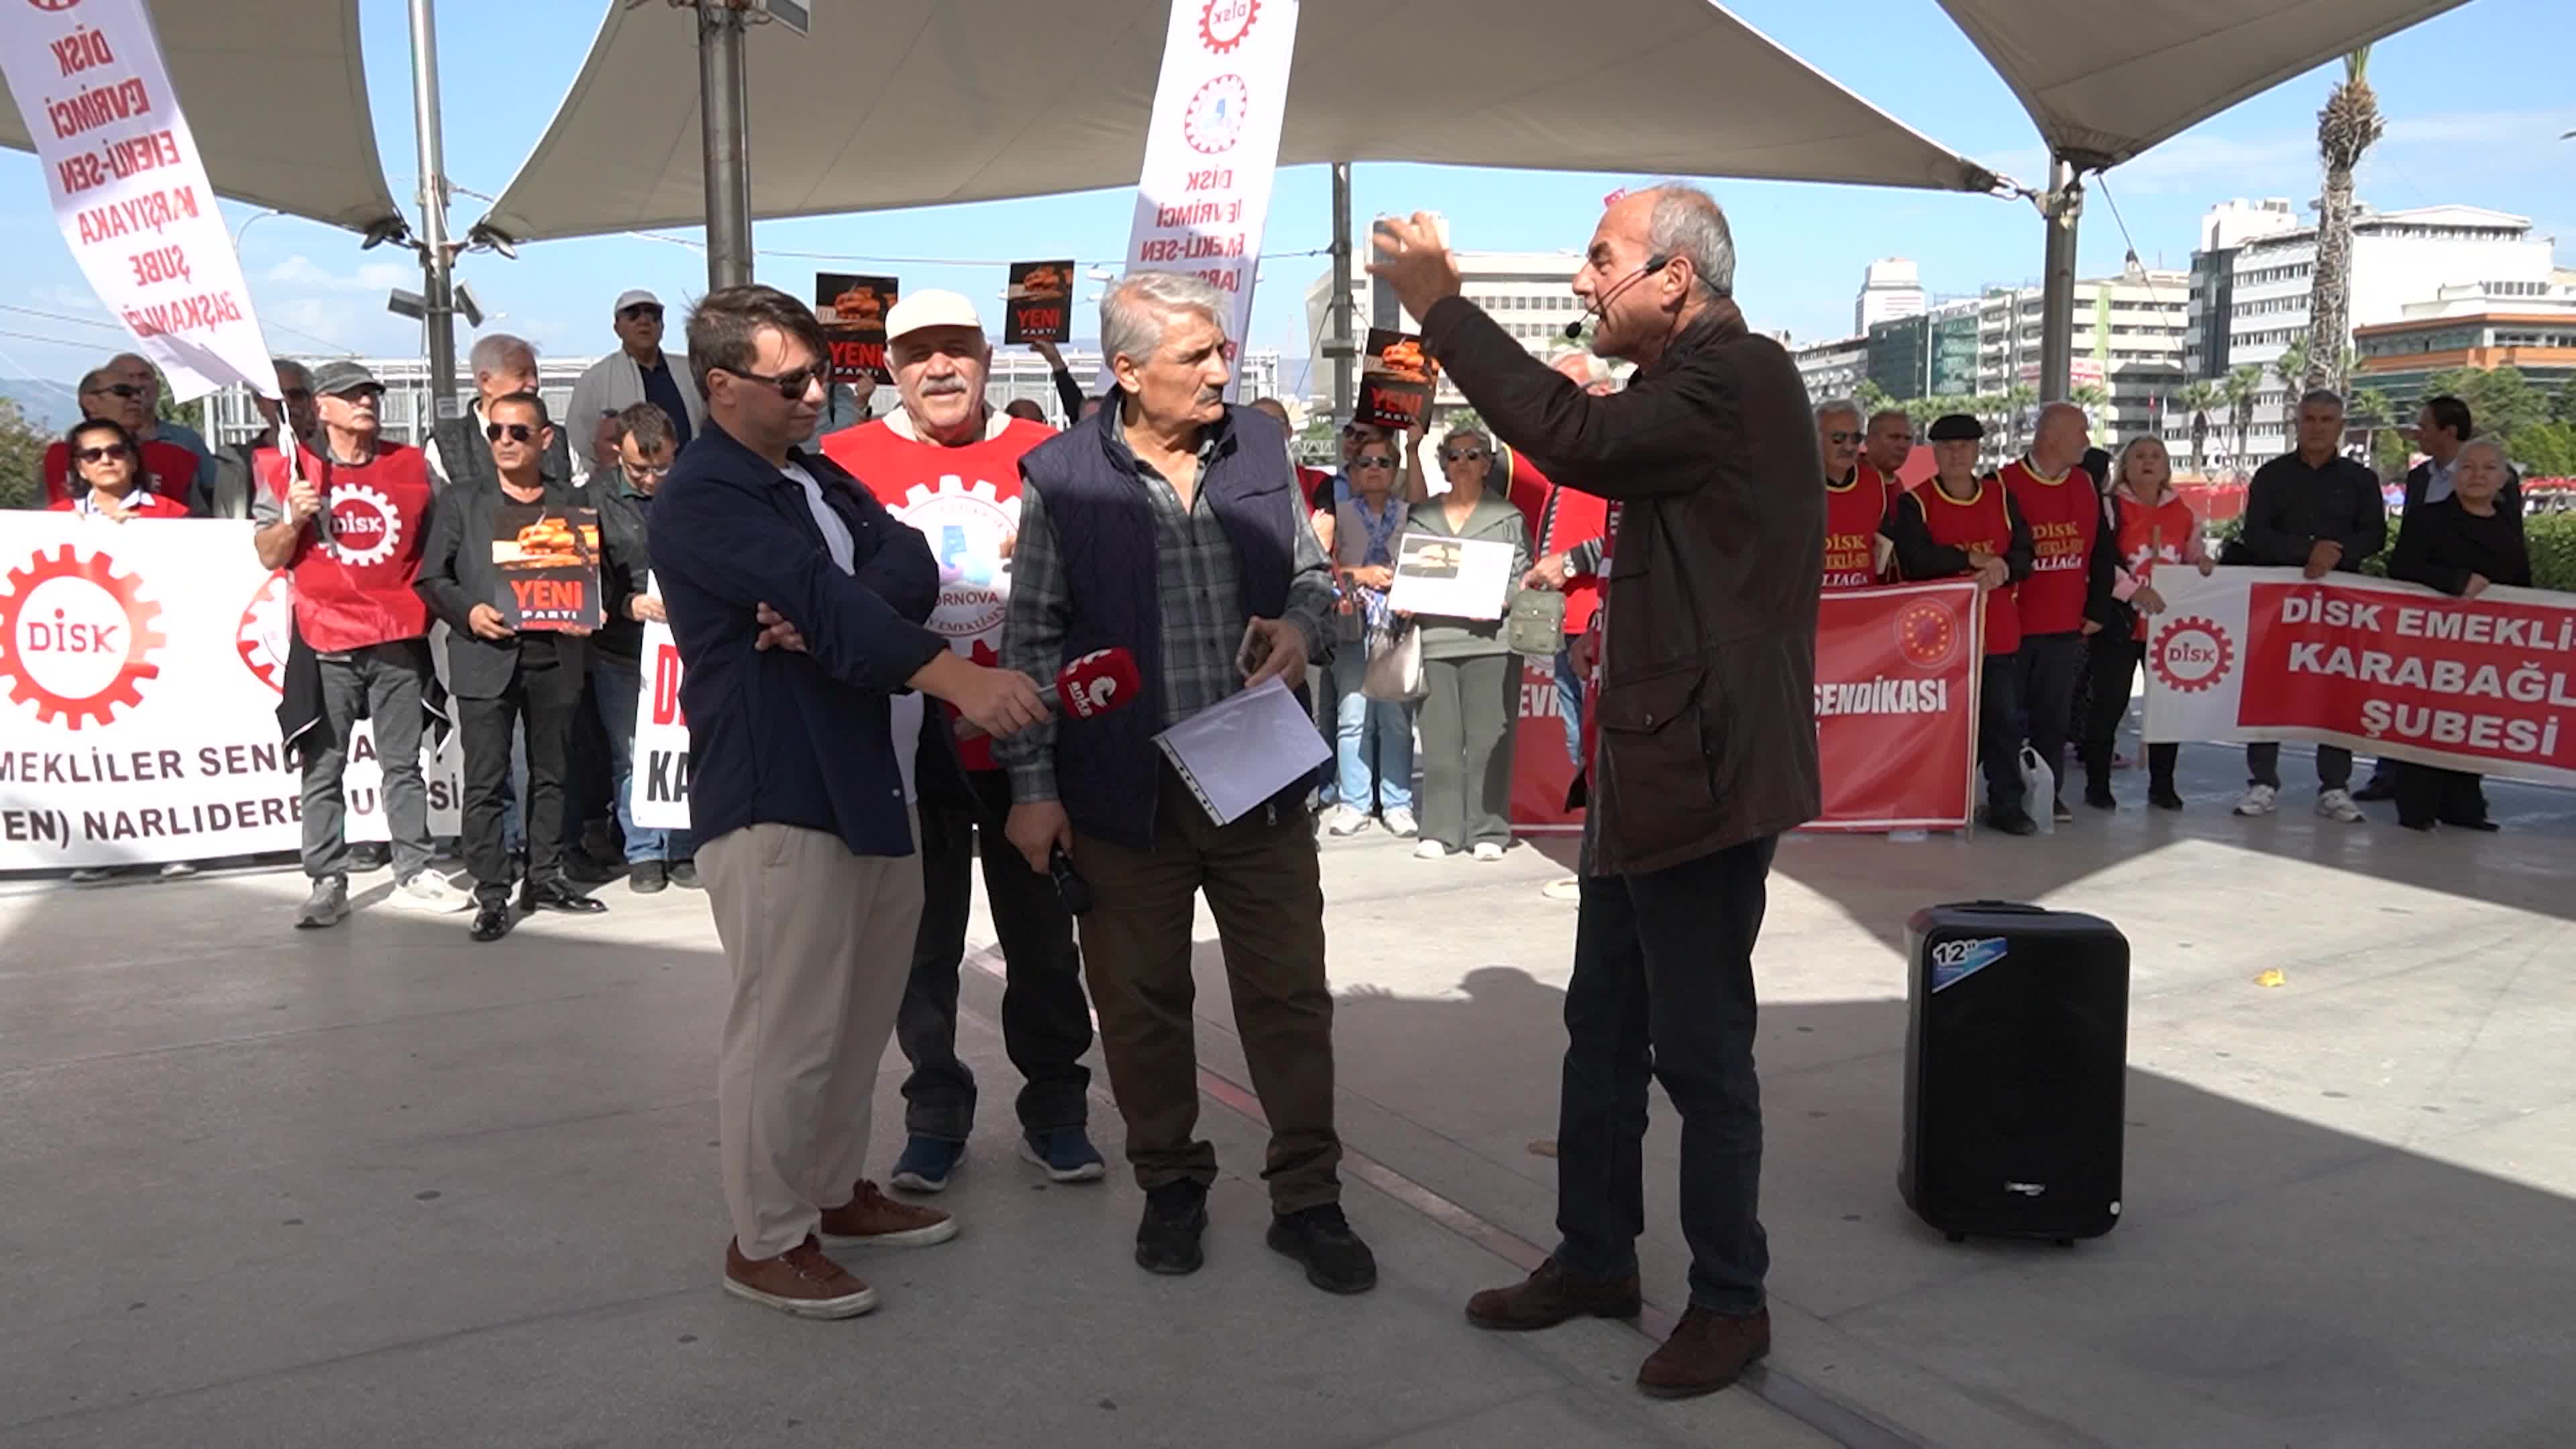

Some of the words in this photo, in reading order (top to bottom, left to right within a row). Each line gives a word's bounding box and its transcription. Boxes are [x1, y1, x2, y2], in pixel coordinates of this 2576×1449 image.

[27, 608, 119, 653] DİSK
[2282, 591, 2383, 632] DİSK
[2396, 608, 2576, 651] EMEKLİ
[2168, 642, 2214, 663] DİSK
[2360, 699, 2559, 755] ŞUBESİ
